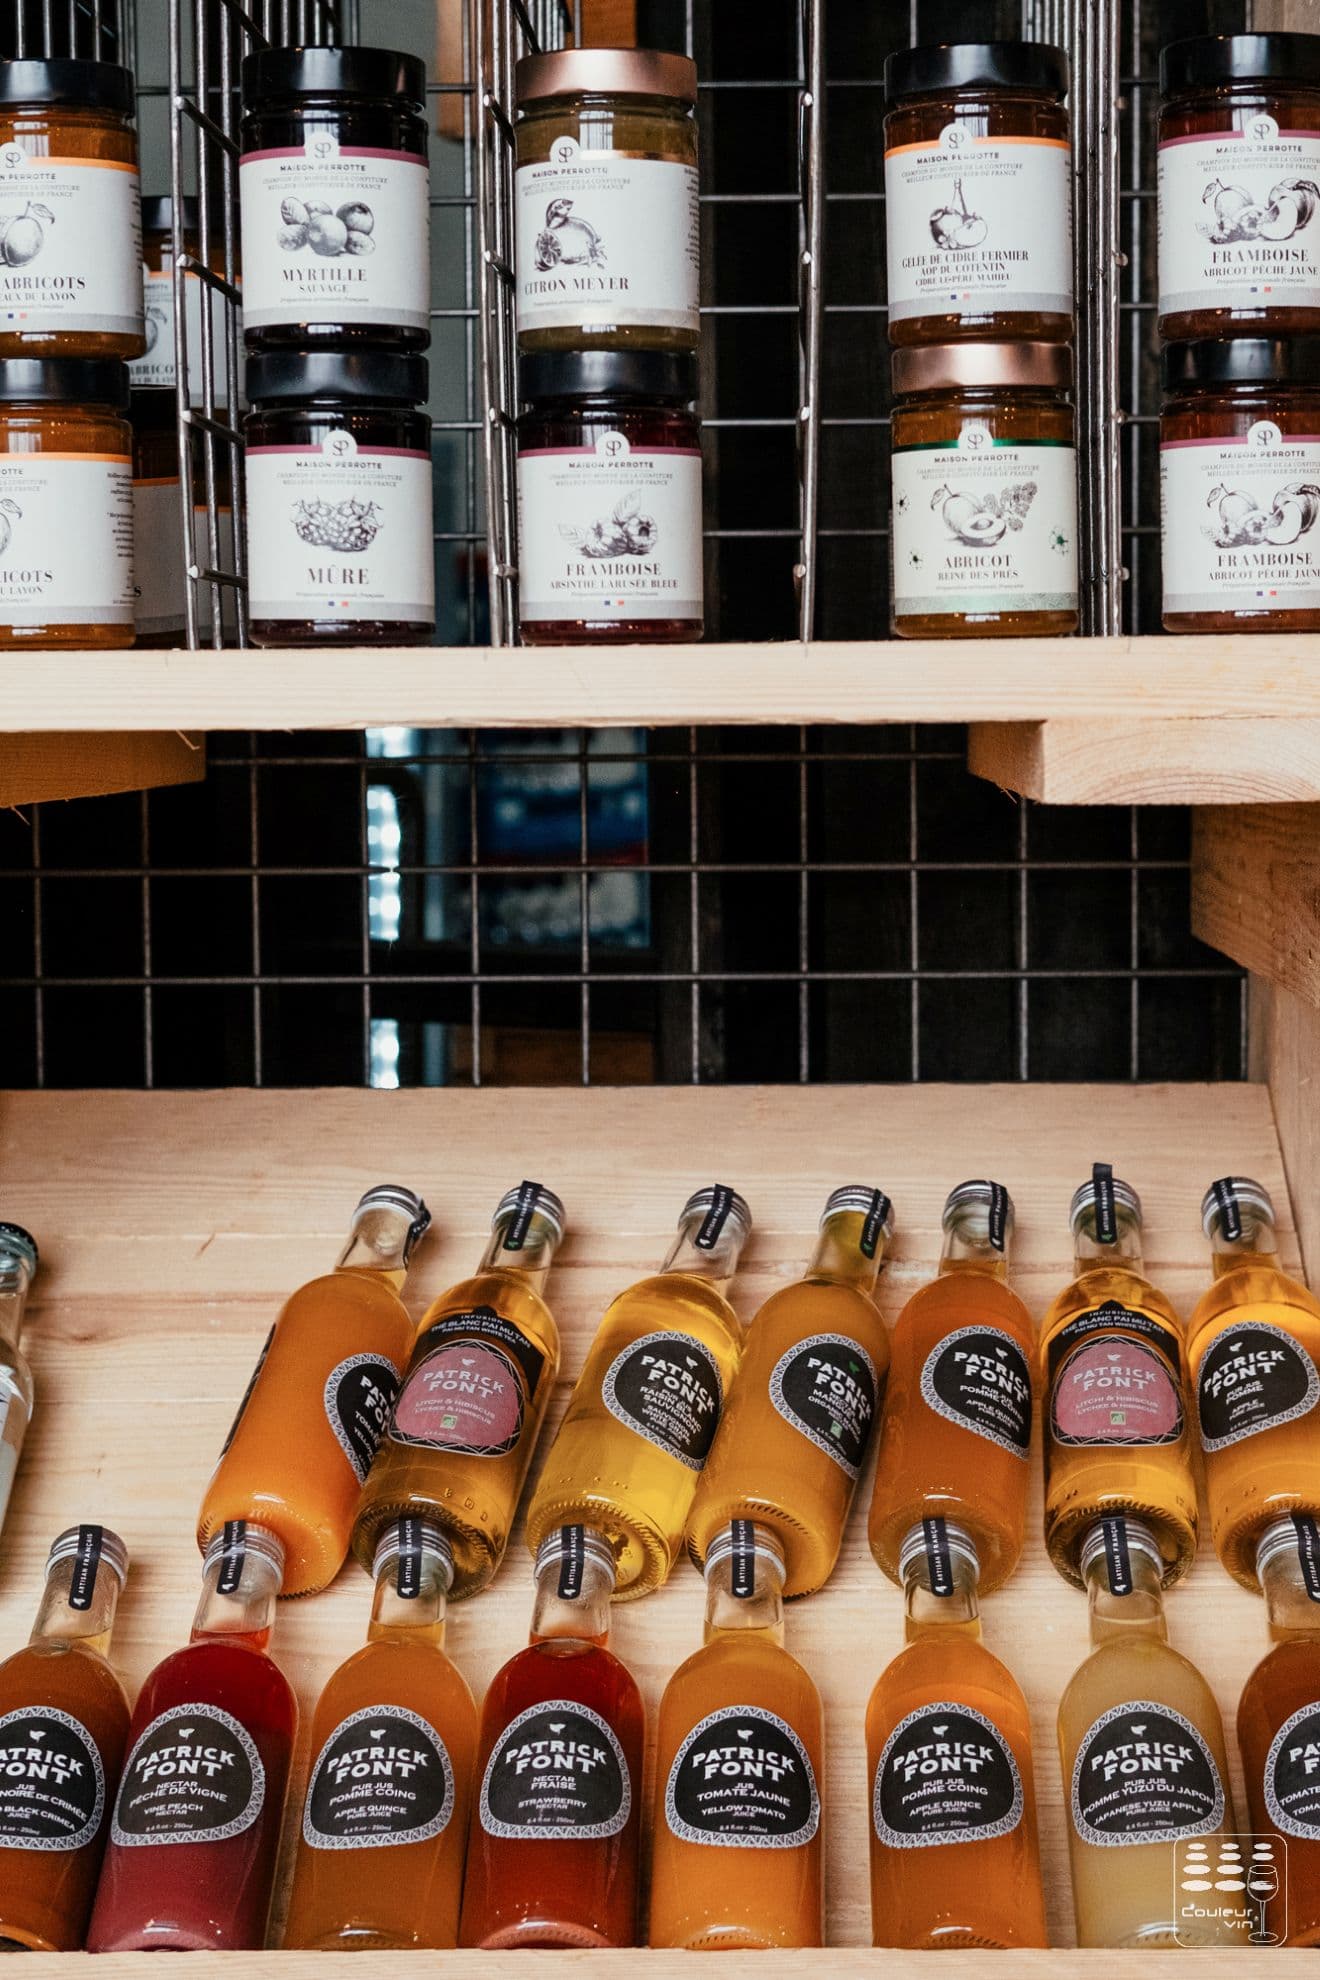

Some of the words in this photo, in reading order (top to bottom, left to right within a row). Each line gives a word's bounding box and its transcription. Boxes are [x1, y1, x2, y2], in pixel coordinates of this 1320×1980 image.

[1216, 146, 1253, 154] MAISON
[917, 155, 948, 164] MAISON
[9, 172, 56, 180] PERROTTE
[280, 164, 315, 172] MAISON
[318, 164, 366, 172] PERROTTE
[532, 169, 558, 178] MAISON
[945, 252, 978, 263] CIDRE
[982, 250, 1029, 261] FERMIER
[1212, 249, 1309, 264] FRAMBOISE
[282, 268, 367, 281] MYRTILLE
[921, 267, 938, 277] AOP
[956, 262, 1005, 273] COTENTIN
[1202, 268, 1247, 278] ABRICOT
[3, 276, 86, 289] ABRICOTS
[524, 279, 567, 296] CITRON
[573, 277, 629, 290] MEYER
[915, 277, 936, 287] CIDRE
[978, 272, 1012, 281] MAHIEU
[41, 292, 76, 301] LAYON
[299, 284, 349, 293] SAUVAGE
[972, 454, 1019, 462] PERROTTE
[1260, 450, 1306, 458] PERROTTE
[296, 461, 330, 469] MAISON
[335, 461, 382, 469] PERROTTE
[569, 461, 604, 469] MAISON
[608, 461, 654, 469] PERROTTE
[944, 554, 1013, 569] ABRICOT
[1217, 552, 1313, 567] FRAMBOISE
[308, 564, 369, 585] MÛRE
[566, 562, 662, 577] FRAMBOISE
[938, 571, 965, 581] REINE
[970, 571, 989, 580] DES
[1208, 571, 1254, 581] ABRICOT
[9, 586, 43, 595] LAYON
[550, 580, 594, 590] ABSINTHE
[650, 579, 679, 588] BLEUE
[461, 1314, 503, 1324] INFUSION
[1078, 1315, 1113, 1327] BLANC
[1089, 1309, 1133, 1317] INFUSION
[448, 1318, 481, 1328] BLANC
[481, 1319, 498, 1331] PAI
[499, 1325, 516, 1337] MU
[954, 1351, 1029, 1401] PATRICK
[1072, 1366, 1157, 1384] PATRICK
[1203, 1350, 1286, 1393] PATRICK
[1212, 1361, 1276, 1398] FONT
[423, 1369, 505, 1394] PATRICK
[428, 1380, 494, 1398] FONT
[640, 1355, 716, 1414] PATRICK
[806, 1357, 873, 1420] PATRICK
[965, 1363, 1025, 1403] FONT
[1083, 1376, 1148, 1392] FONT
[647, 1369, 707, 1414] FONT
[661, 1388, 679, 1401] PUR
[814, 1371, 866, 1420] FONT
[959, 1384, 999, 1403] POMME
[1225, 1384, 1265, 1405] POMME
[640, 1386, 675, 1405] RAISIN
[676, 1402, 702, 1432] BLANC
[966, 1399, 994, 1412] APPLE
[1232, 1398, 1259, 1414] APPLE
[642, 1407, 668, 1422] WHITE
[643, 1394, 697, 1434] SAUVIGNON
[647, 1405, 690, 1437] SAUVIGNON
[135, 1745, 237, 1774] PATRICK
[326, 1746, 429, 1774] PATRICK
[504, 1739, 607, 1765] PATRICK
[691, 1746, 796, 1773] PATRICK
[893, 1741, 994, 1773] PATRICK
[1091, 1742, 1194, 1771] PATRICK
[141, 1759, 223, 1783] FONT
[515, 1754, 596, 1775] FONT
[703, 1761, 785, 1782] FONT
[904, 1756, 984, 1783] FONT
[1103, 1756, 1184, 1781] FONT
[335, 1761, 417, 1785] FONT
[532, 1775, 575, 1783] NECTAR
[156, 1780, 198, 1789] NECTAR
[351, 1782, 374, 1791] PUR
[374, 1781, 394, 1789] JUS
[530, 1781, 577, 1791] FRAISE
[734, 1782, 755, 1790] JUS
[922, 1779, 945, 1788] PUR
[945, 1777, 965, 1786] JUS
[1124, 1778, 1146, 1788] PUR
[1146, 1777, 1167, 1786] JUS
[0, 1790, 35, 1798] NOIRE
[35, 1793, 49, 1802] DE
[169, 1787, 187, 1795] DE
[189, 1788, 228, 1803] VIGNE
[328, 1788, 374, 1807] POMME
[375, 1788, 417, 1801] COING
[696, 1788, 748, 1802] TOMATE
[749, 1789, 791, 1807] JAUNE
[902, 1785, 945, 1805] POMME
[947, 1784, 989, 1796] COING
[1083, 1789, 1120, 1817] POMME
[1121, 1784, 1154, 1796] YUZU
[1157, 1784, 1175, 1792] DU
[1177, 1787, 1215, 1806] JAPON
[1279, 1785, 1320, 1807] TOMATE
[144, 1805, 166, 1815] VINE
[167, 1802, 203, 1812] PEACH
[518, 1797, 587, 1809] STRAWBERRY
[909, 1801, 941, 1817] APPLE
[942, 1800, 982, 1810] QUINCE
[4, 1805, 39, 1815] BLACK
[40, 1809, 76, 1832] CRIMEA
[334, 1805, 367, 1820] APPLE
[367, 1804, 408, 1816] QUINCE
[347, 1811, 368, 1821] PURE
[368, 1810, 392, 1818] JUICE
[701, 1804, 744, 1817] YELLOW
[744, 1804, 786, 1820] TOMATO
[1093, 1801, 1141, 1825] JAPANESE
[1142, 1800, 1170, 1808] YUZU
[1172, 1801, 1205, 1815] APPLE
[1126, 1808, 1148, 1817] PURE
